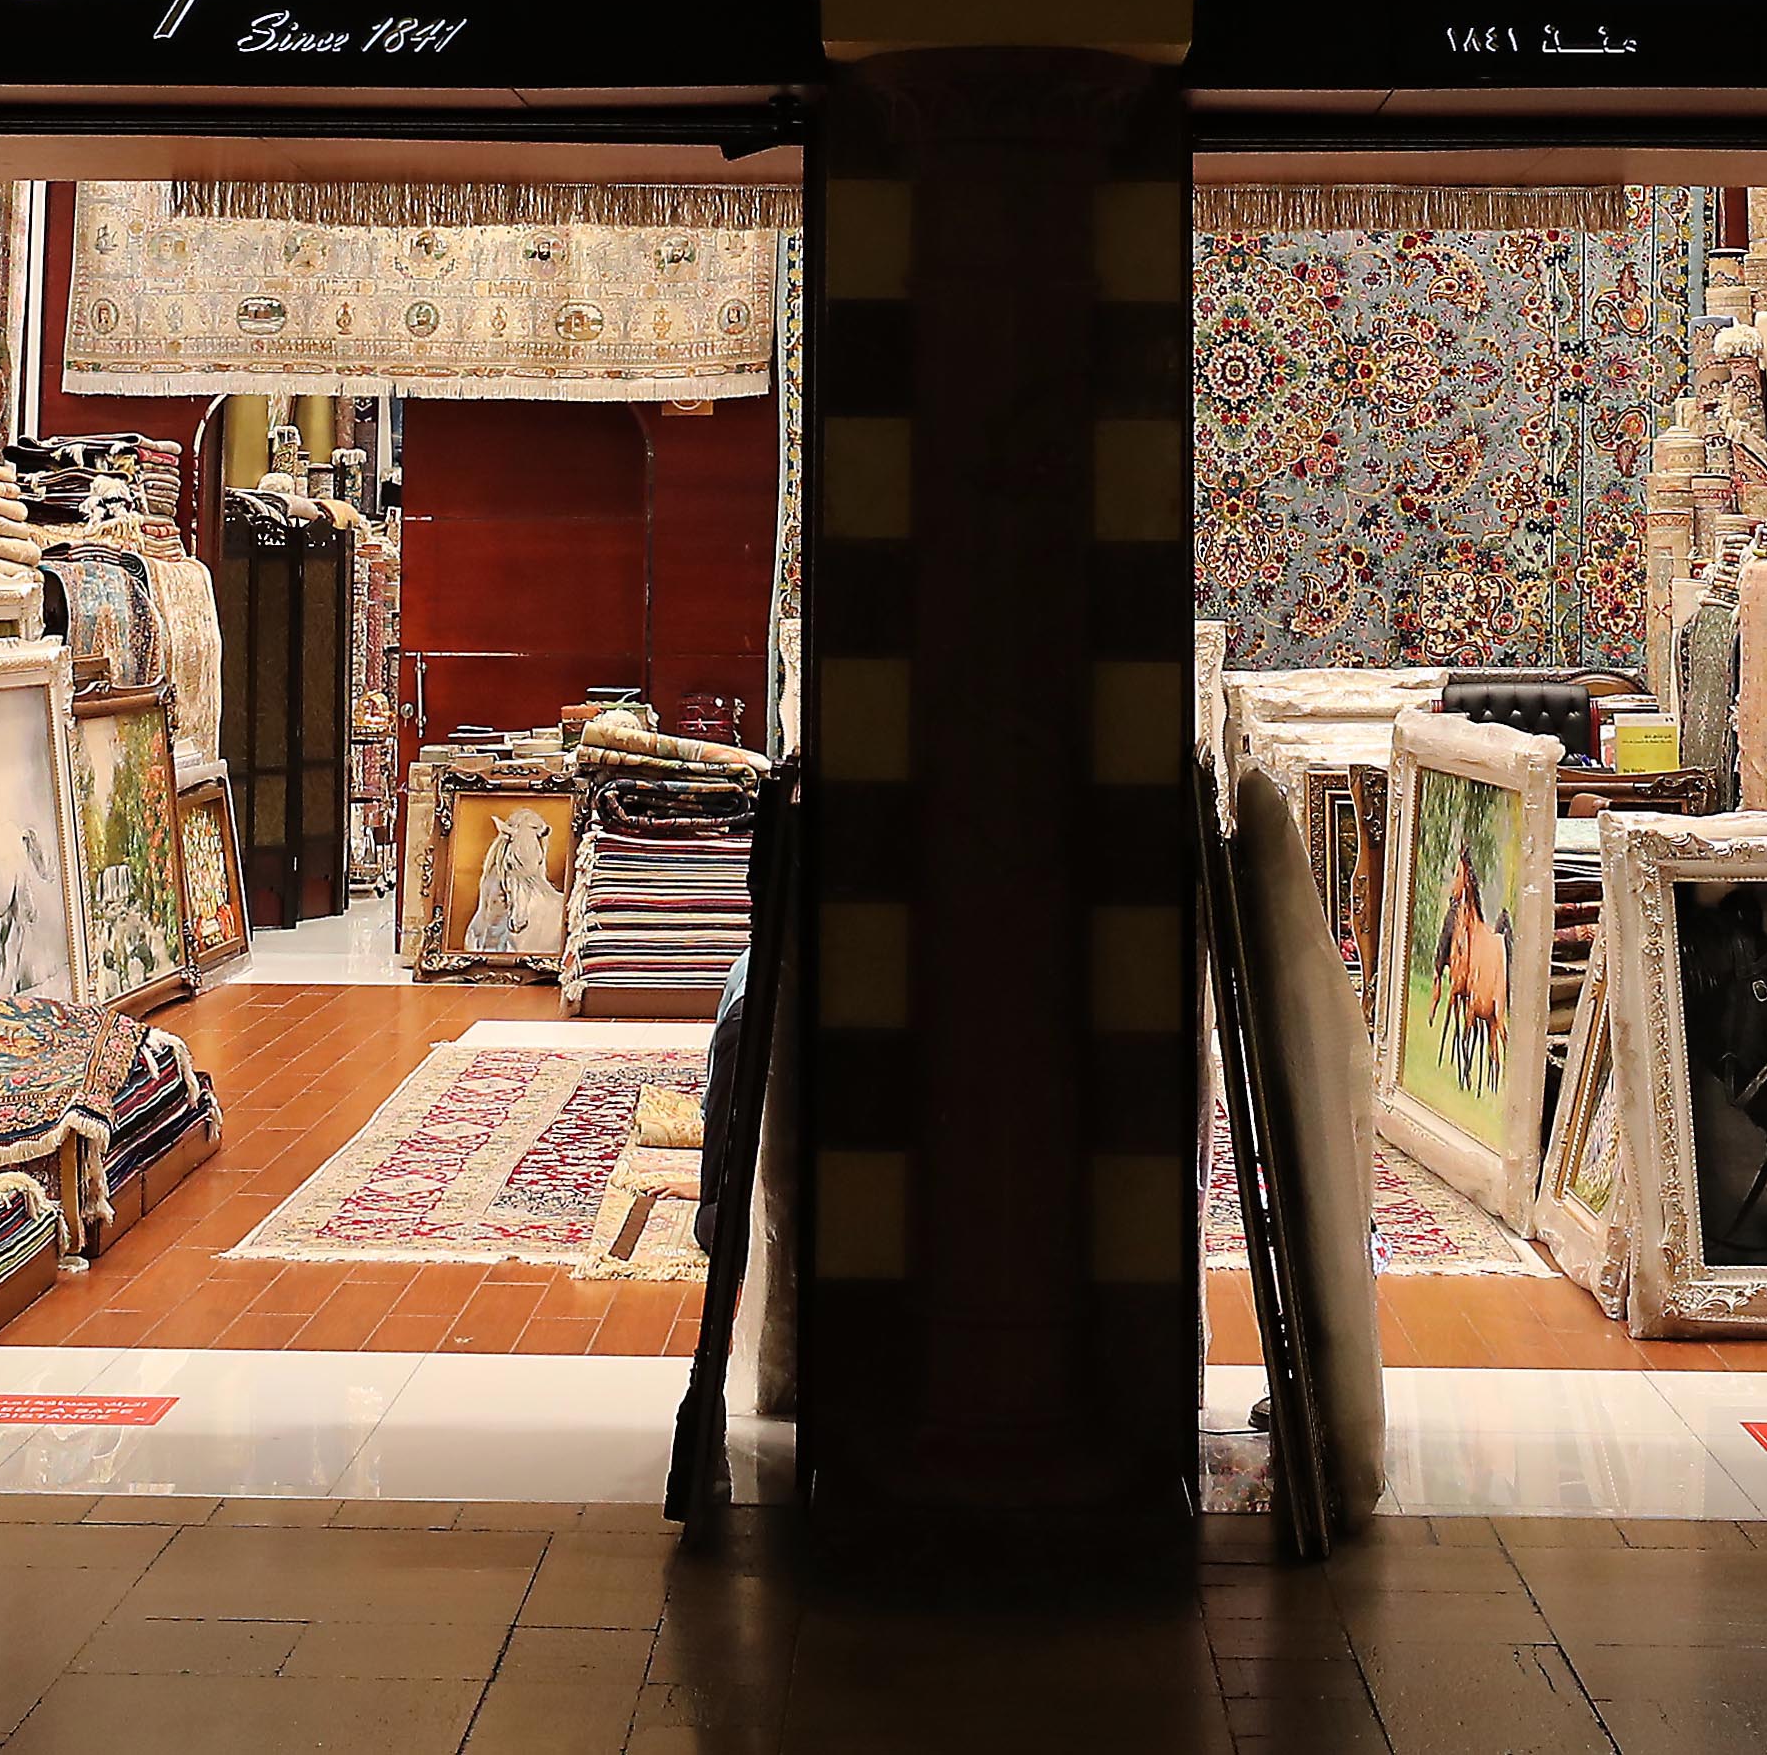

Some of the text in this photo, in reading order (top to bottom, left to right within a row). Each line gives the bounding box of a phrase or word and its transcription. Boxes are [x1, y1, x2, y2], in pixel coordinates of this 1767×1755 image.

[236, 9, 469, 55] Since 1841
[1446, 23, 1638, 54] منذ ١٨٤١
[74, 1407, 135, 1415] SAFE
